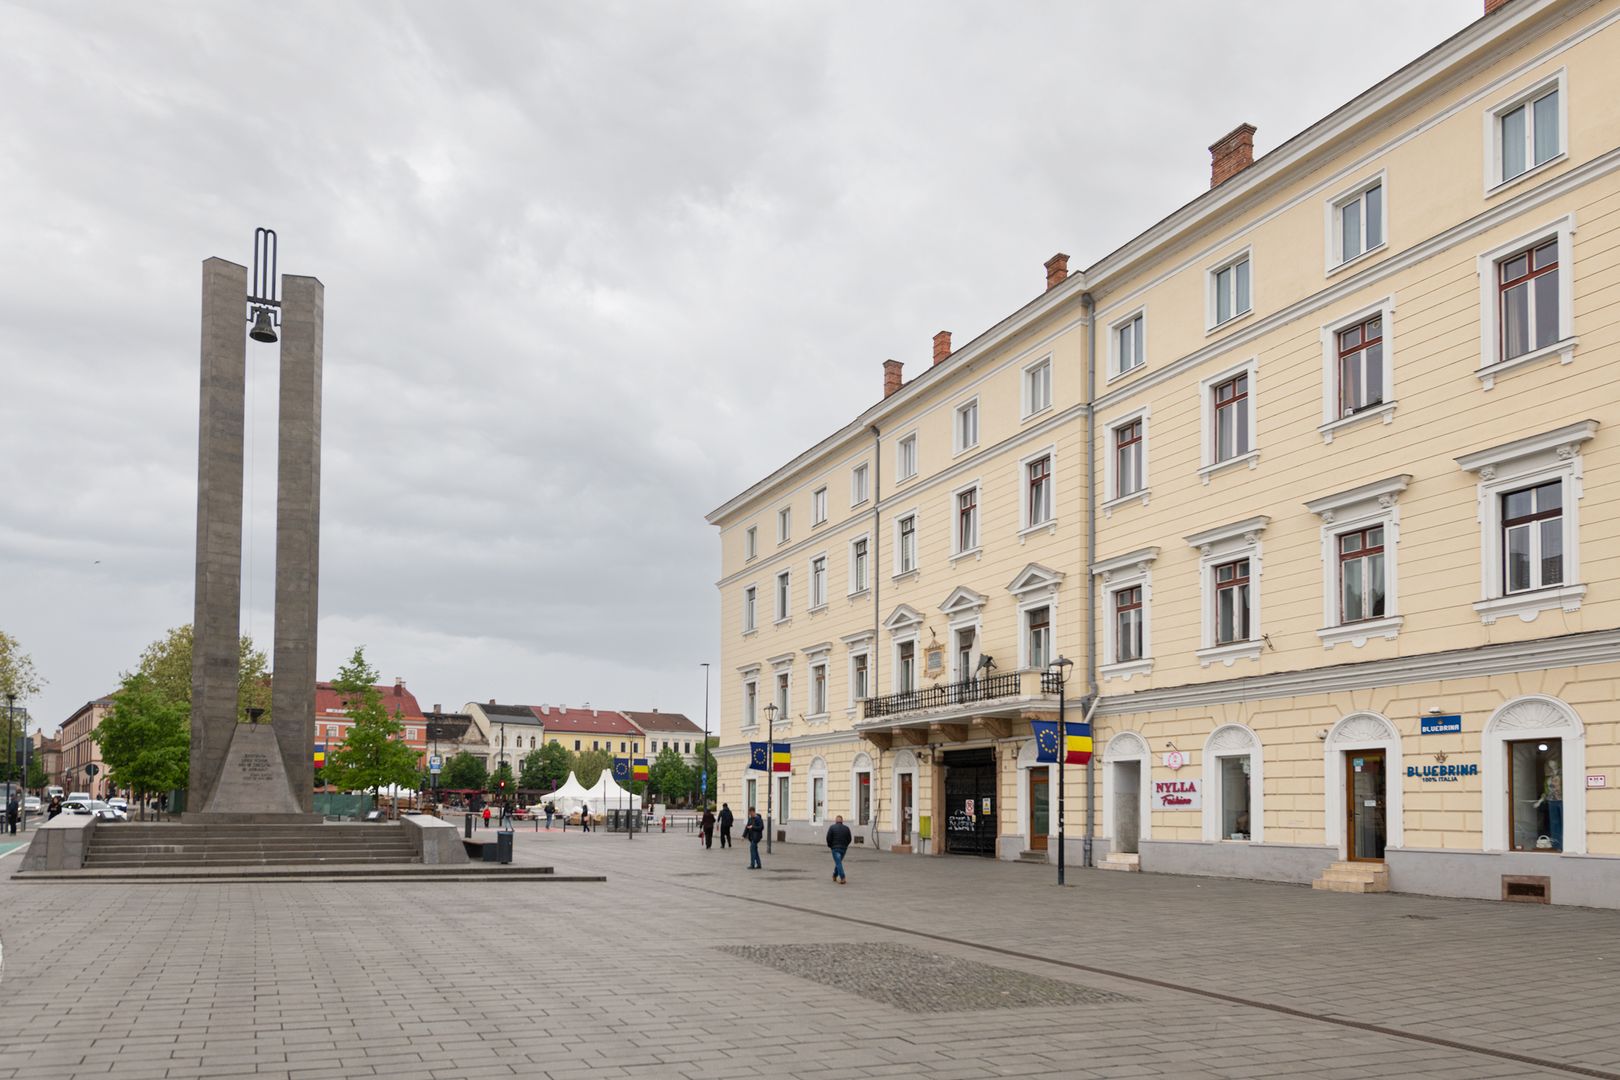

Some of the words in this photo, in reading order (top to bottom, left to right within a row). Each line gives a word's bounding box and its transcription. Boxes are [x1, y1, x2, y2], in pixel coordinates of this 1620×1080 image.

[1422, 724, 1459, 732] BLUEBRINA
[1407, 764, 1478, 777] BLUEBRINA
[1156, 782, 1197, 793] NYLLA
